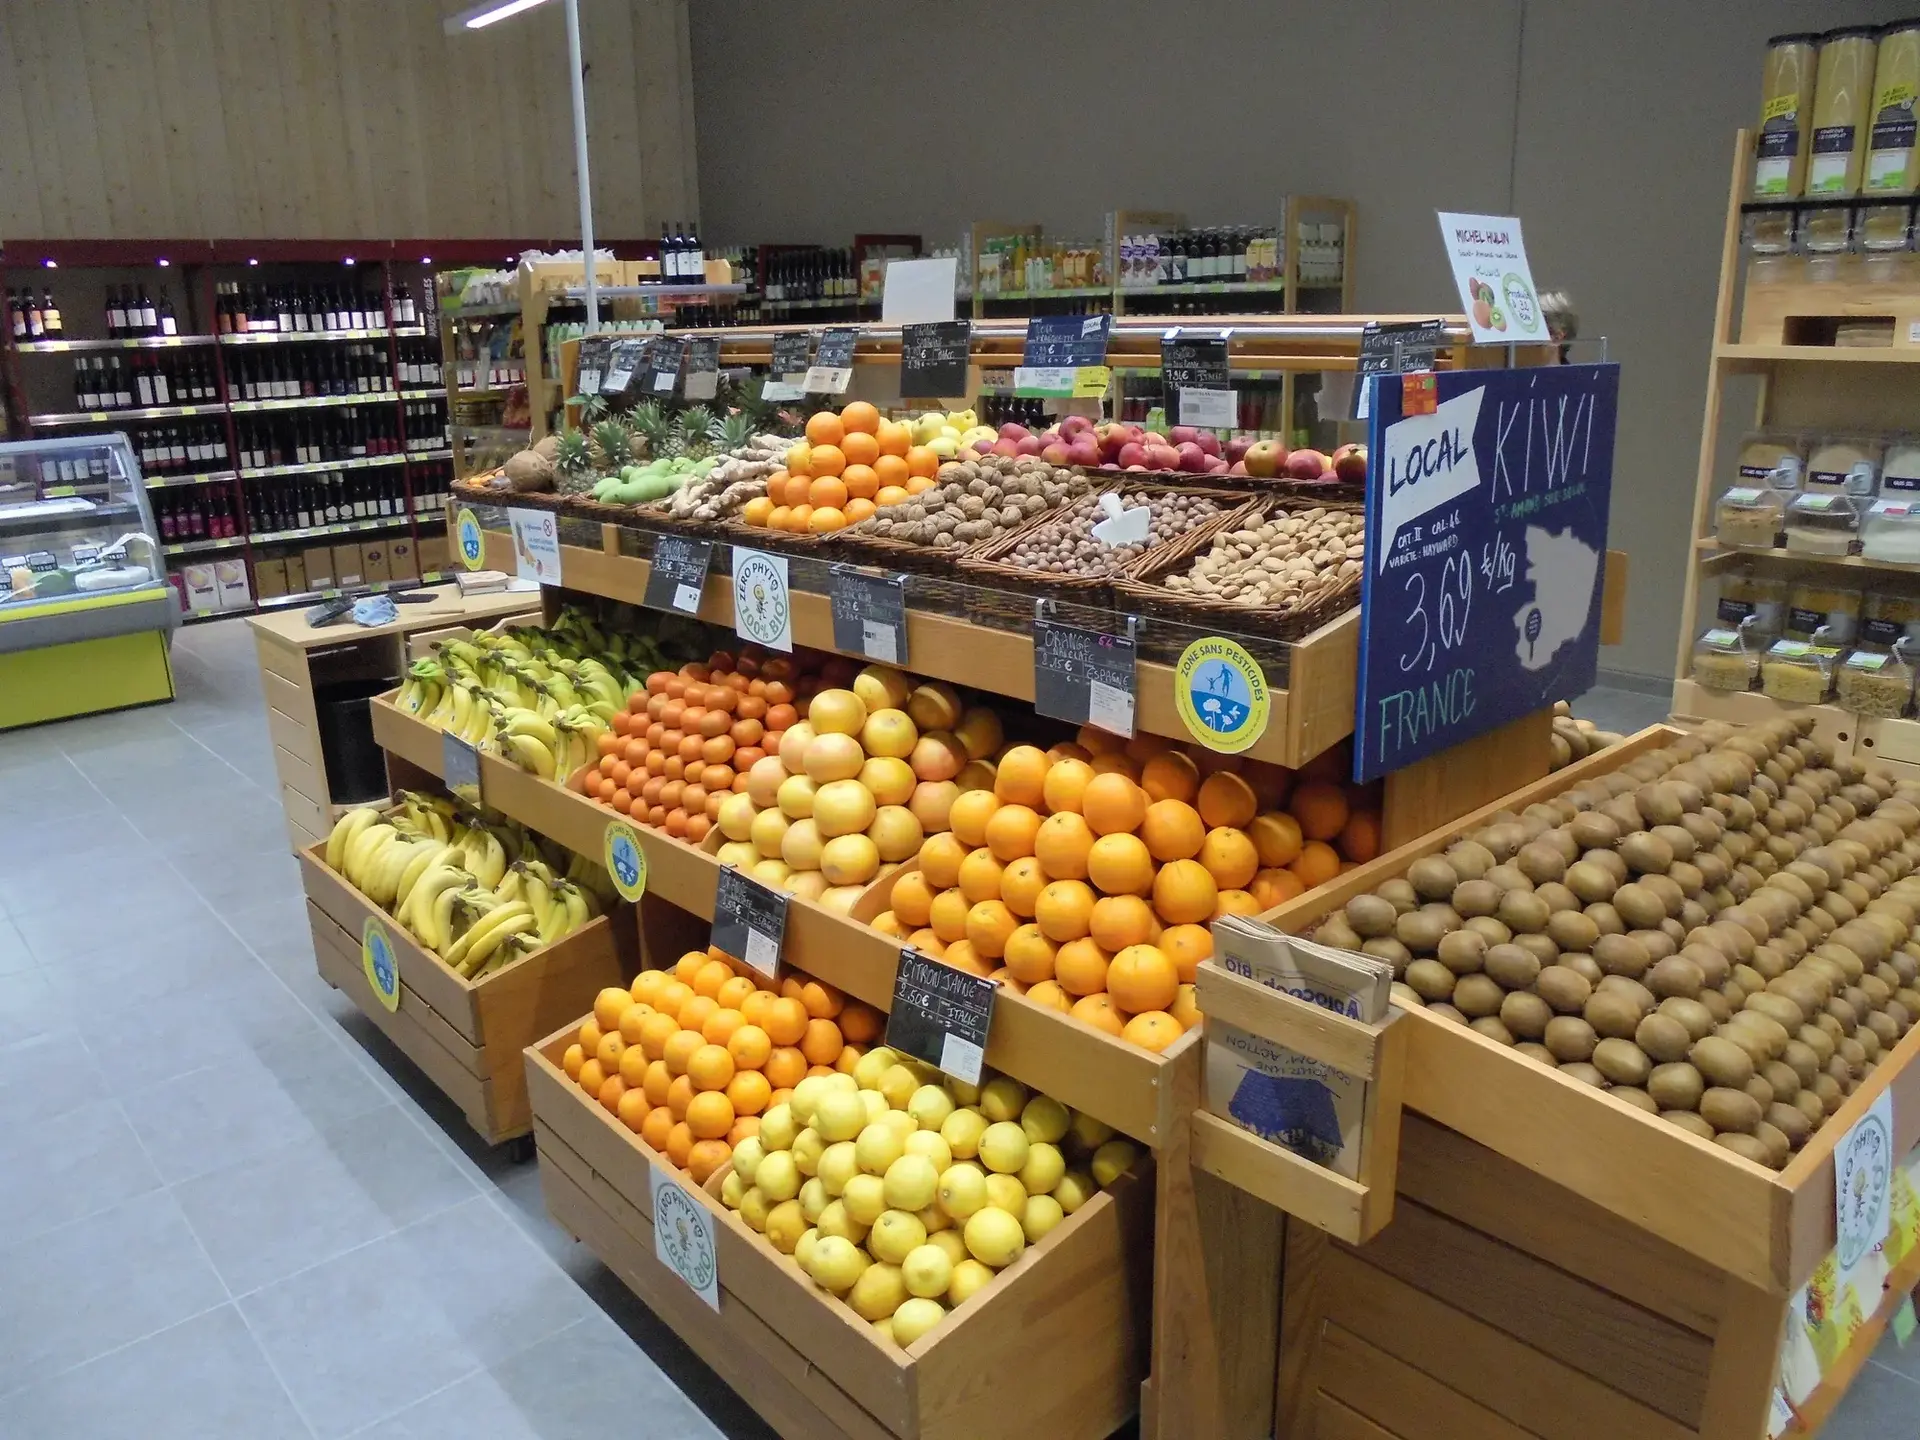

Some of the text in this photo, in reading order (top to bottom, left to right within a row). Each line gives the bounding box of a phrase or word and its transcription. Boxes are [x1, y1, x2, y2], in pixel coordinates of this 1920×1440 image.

[1456, 229, 1485, 243] MICHEL
[1390, 426, 1469, 497] LOCAL
[752, 562, 779, 592] PHYTO
[742, 601, 785, 640] 100% BIO
[1400, 549, 1473, 672] 3,69
[1181, 644, 1264, 702] ZONE SANS PESTICIDES
[1379, 668, 1477, 762] FRANCE
[902, 959, 942, 988] CITRON
[947, 1008, 979, 1026] ITALIE
